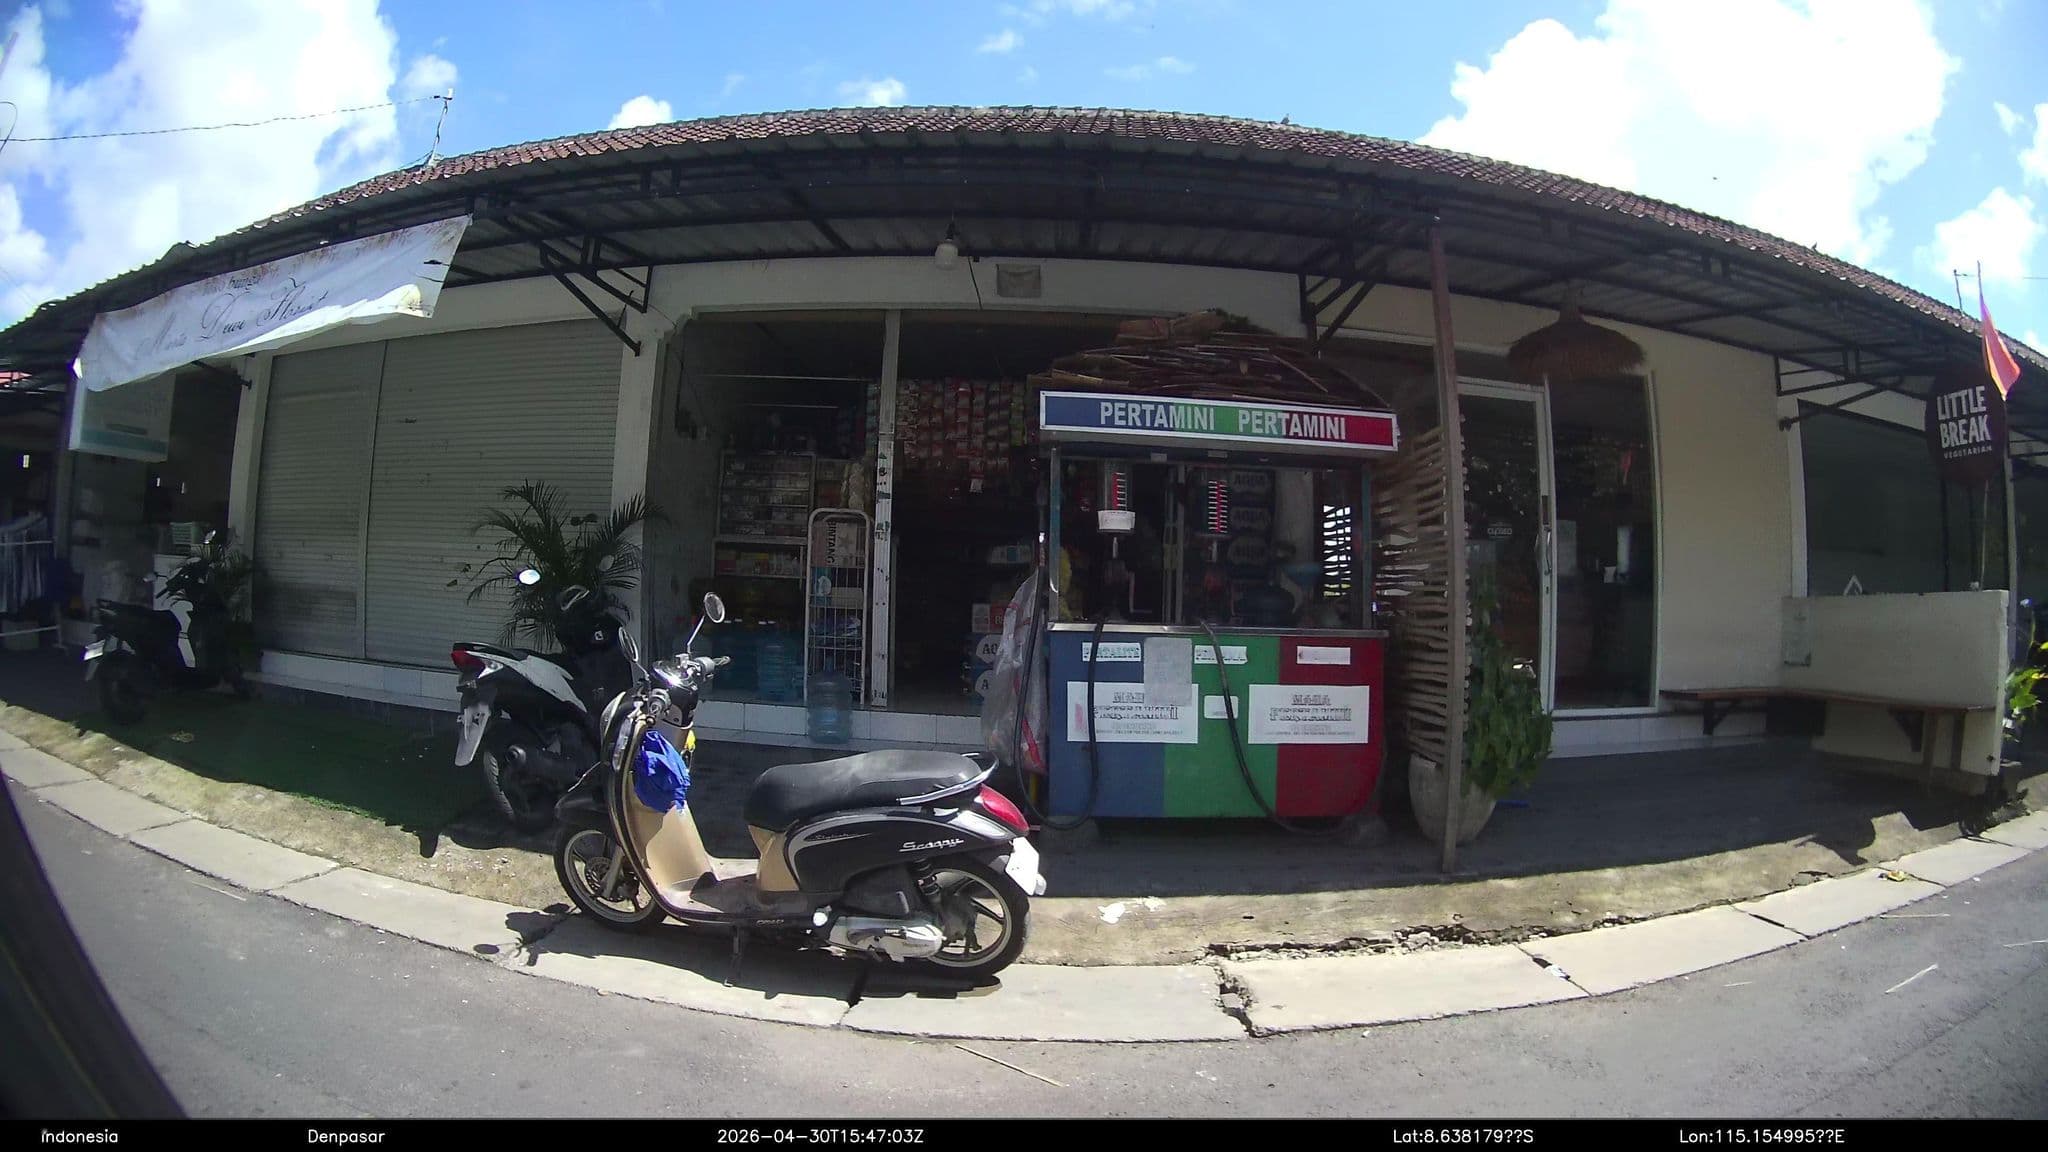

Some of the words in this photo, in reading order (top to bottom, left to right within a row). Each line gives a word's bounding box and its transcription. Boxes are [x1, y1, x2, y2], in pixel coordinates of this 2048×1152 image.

[1100, 401, 1215, 431] PERTAMINI
[1238, 409, 1346, 440] PERTAMINI
[1936, 386, 1987, 421] LITTLE
[1939, 415, 1992, 449] BREAK
[1943, 445, 1993, 459] VEGETARIAN
[824, 520, 837, 564] BINTANG
[899, 838, 964, 853] Scoopy
